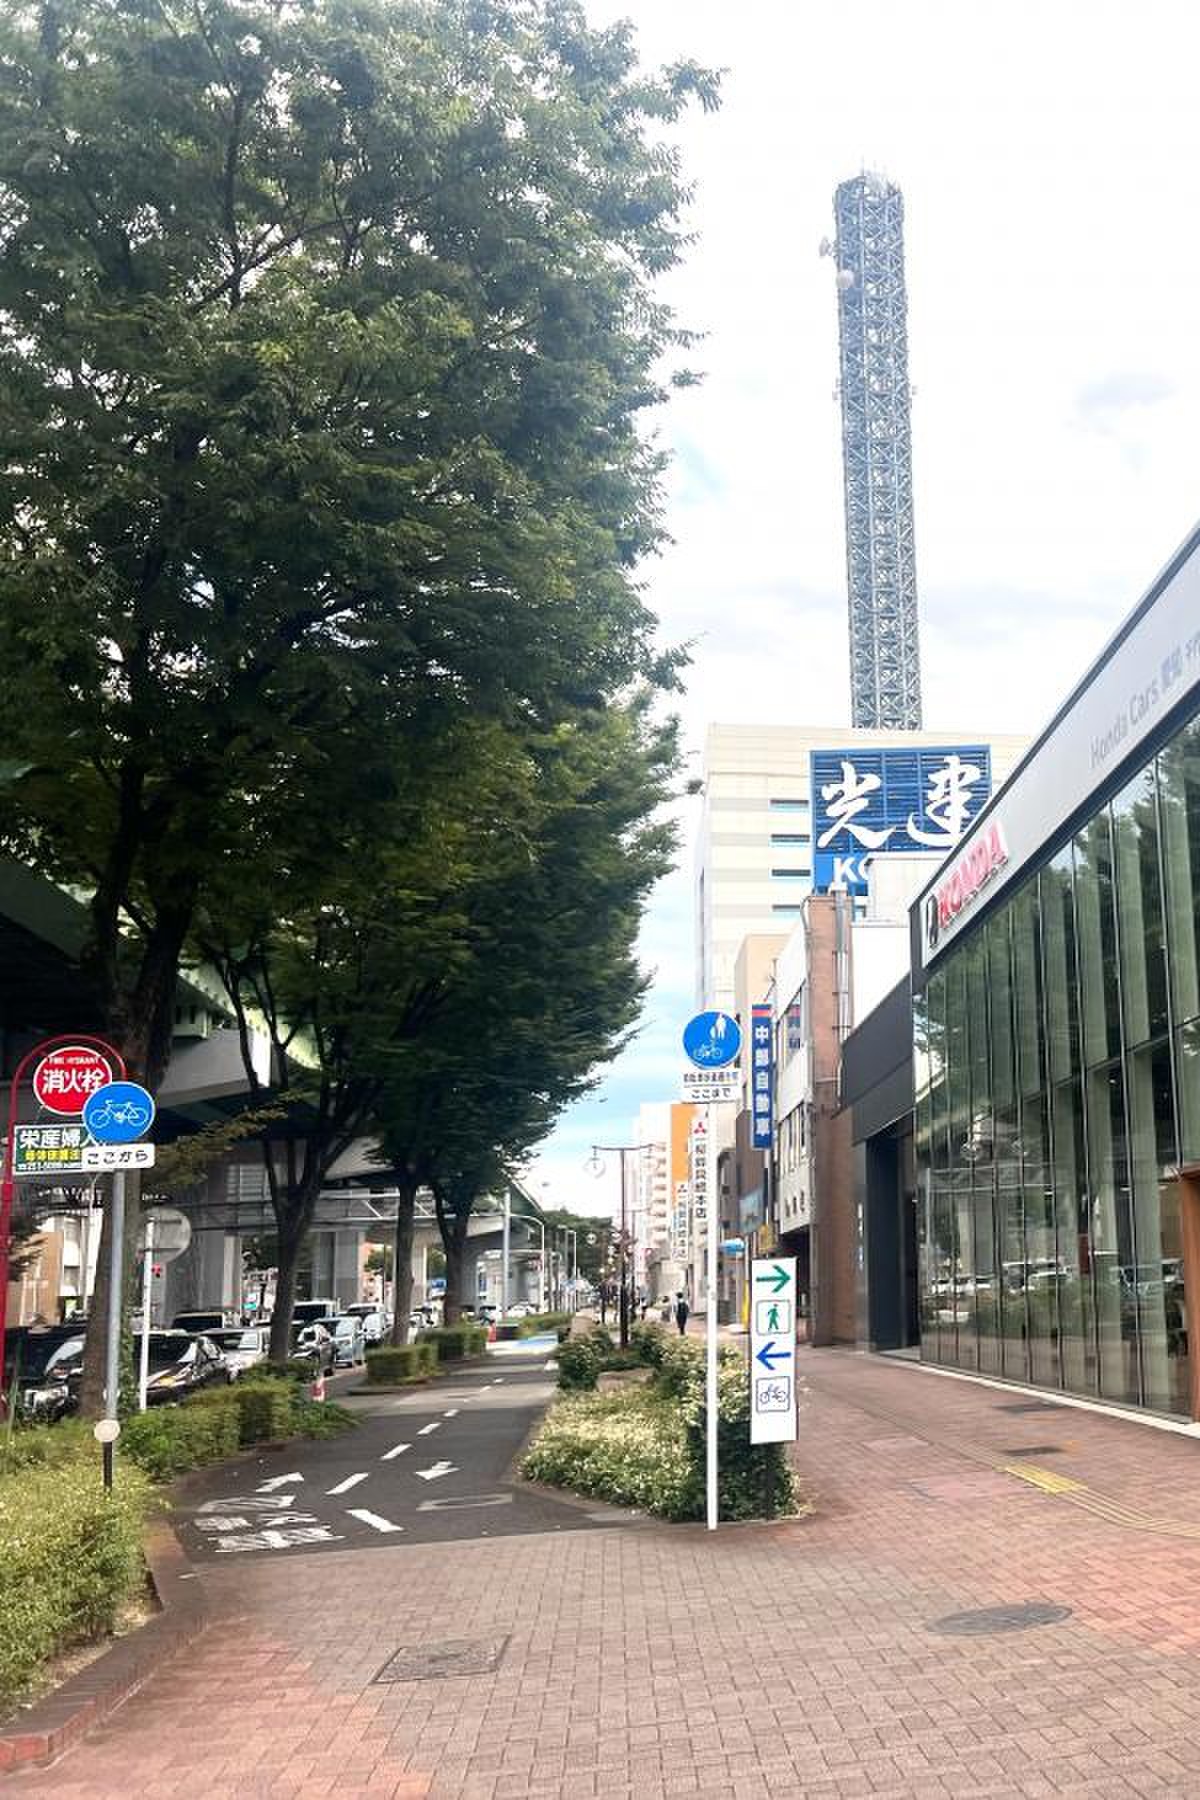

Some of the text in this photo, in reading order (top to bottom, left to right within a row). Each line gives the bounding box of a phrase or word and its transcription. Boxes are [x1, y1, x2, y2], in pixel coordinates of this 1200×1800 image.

[936, 820, 1009, 930] HONDA
[41, 1067, 105, 1094] 消火栓
[691, 1087, 731, 1099] ここまで
[19, 1128, 106, 1150] 栄産婦人
[87, 1150, 149, 1165] ここから
